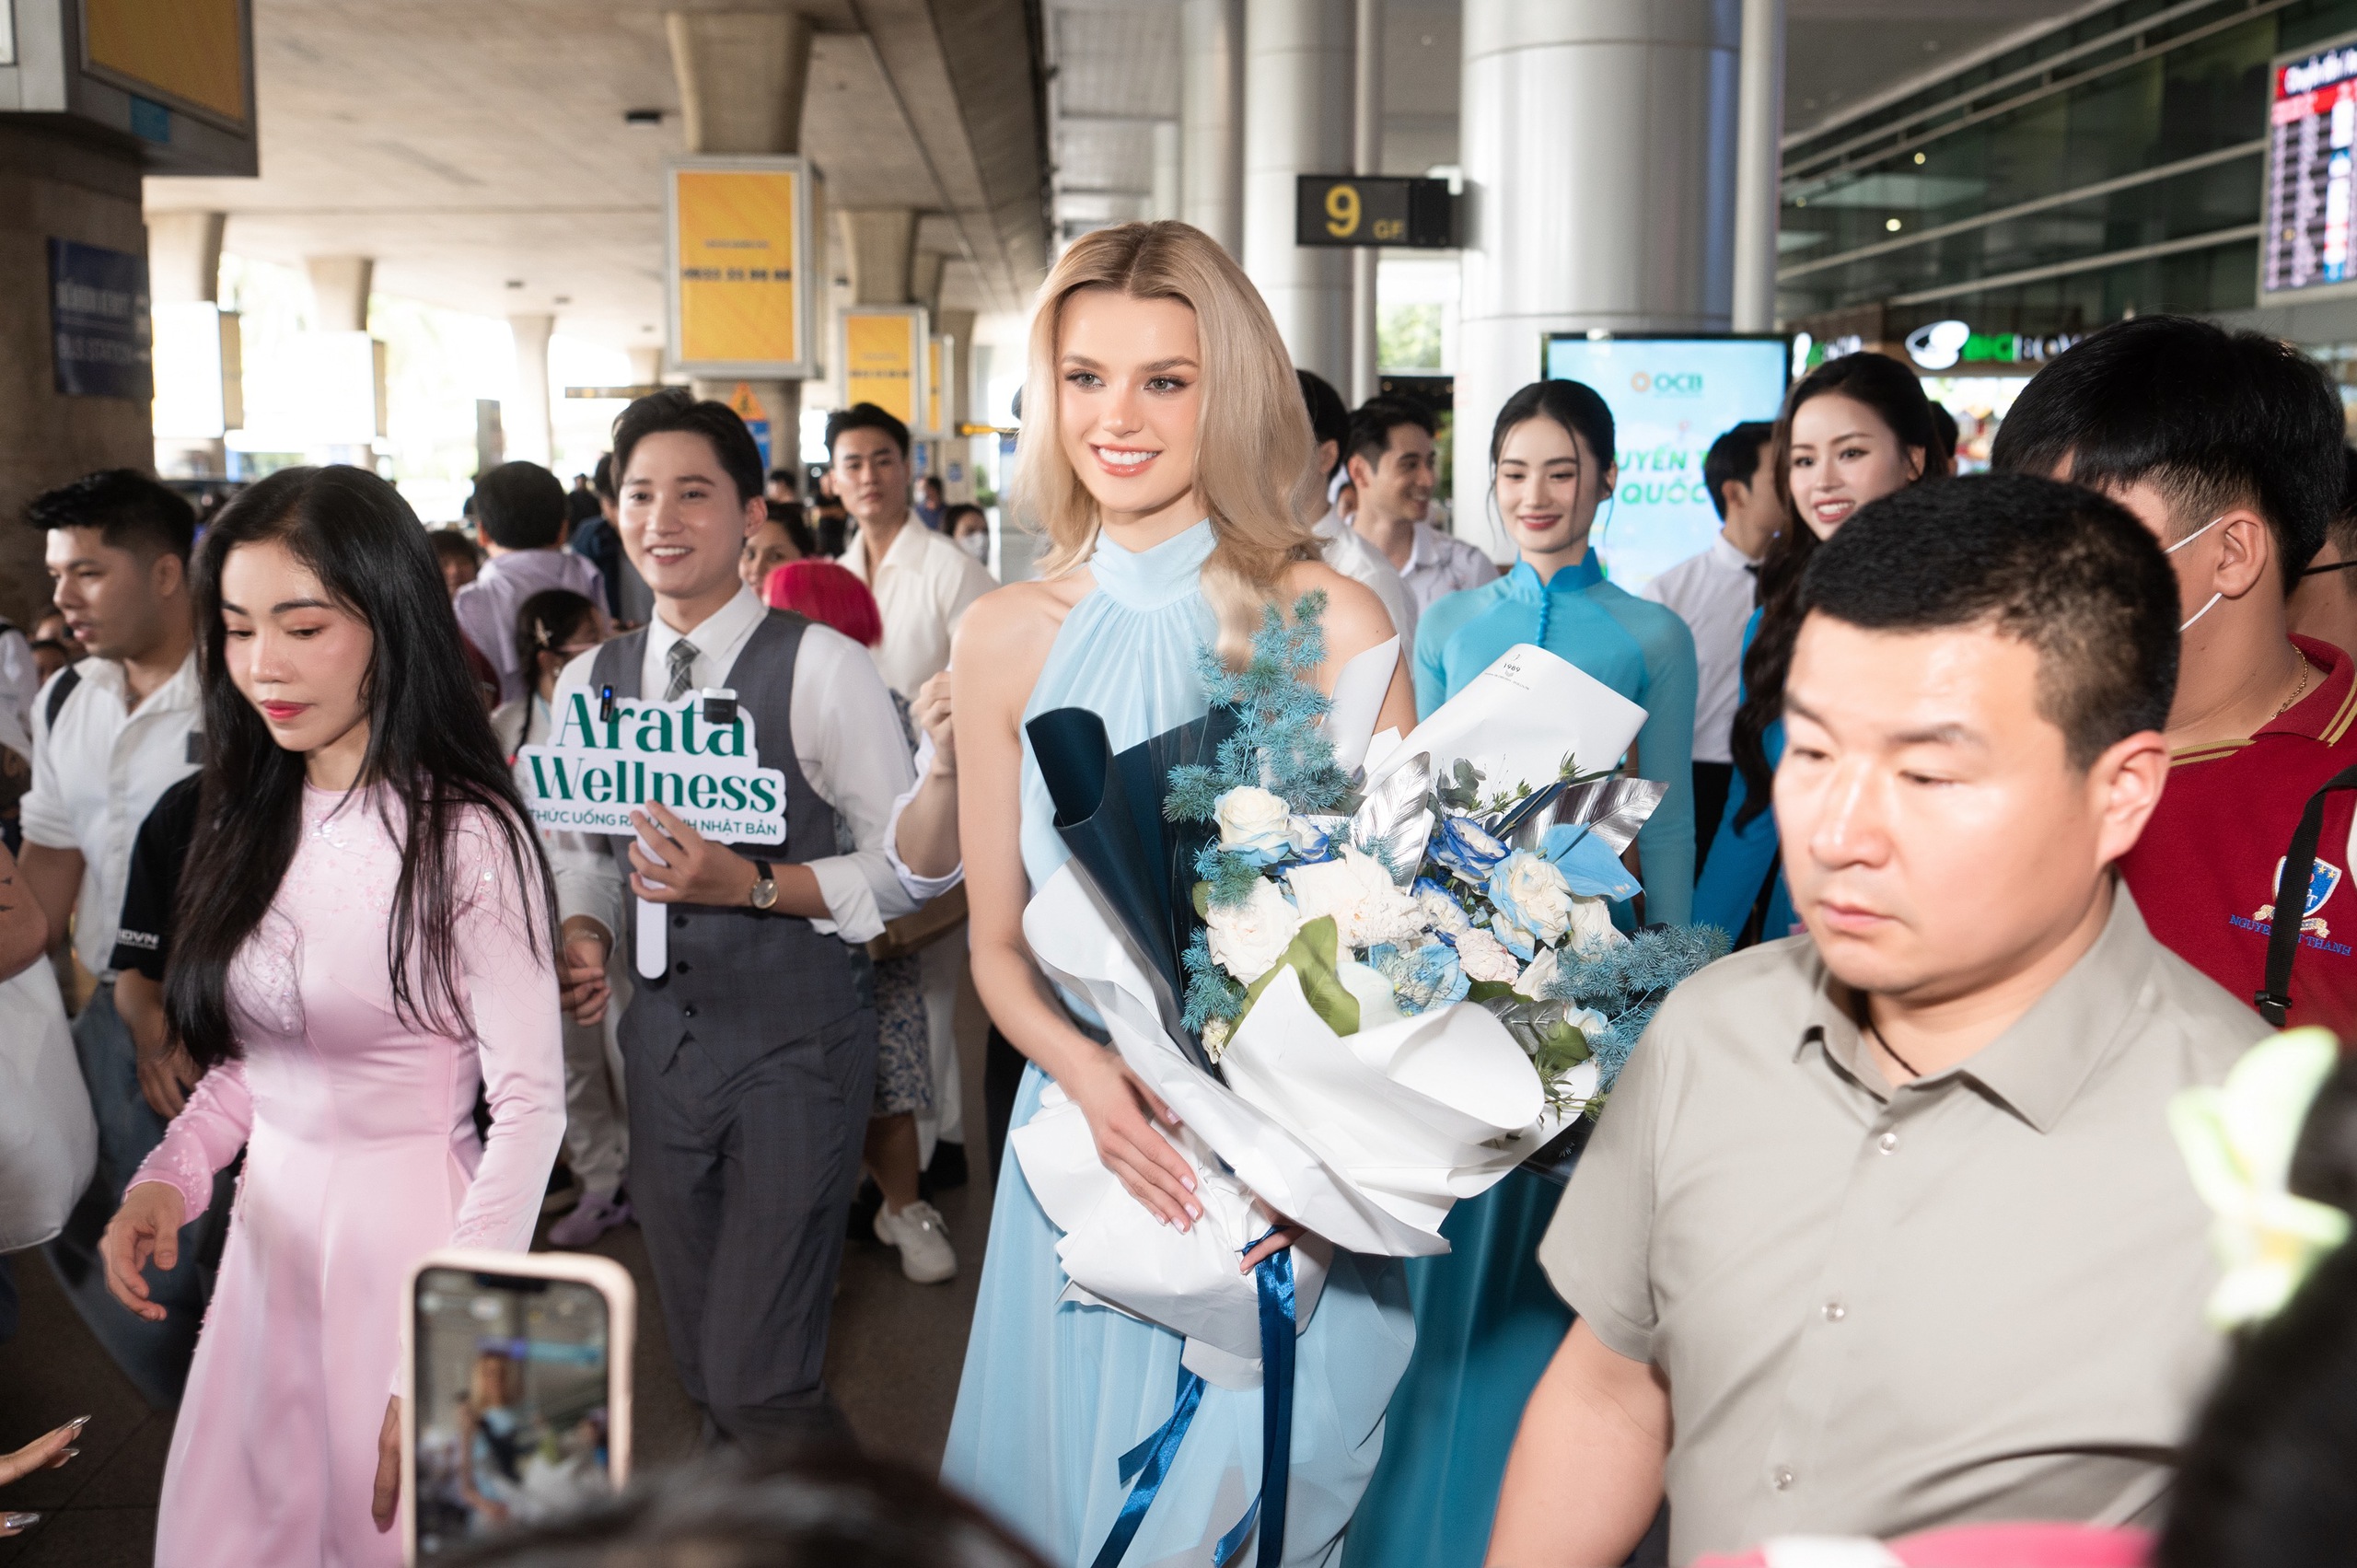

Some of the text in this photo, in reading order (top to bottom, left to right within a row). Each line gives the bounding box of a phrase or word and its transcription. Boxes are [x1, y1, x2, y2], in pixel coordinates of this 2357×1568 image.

[1326, 184, 1360, 238] 9
[556, 692, 748, 757] Arata
[528, 755, 777, 813] Wellness
[572, 808, 616, 826] UỐNG
[701, 819, 742, 836] NHẬT
[746, 819, 777, 836] BẢN
[2229, 913, 2272, 936] NGUYE
[2305, 935, 2352, 957] THANH
